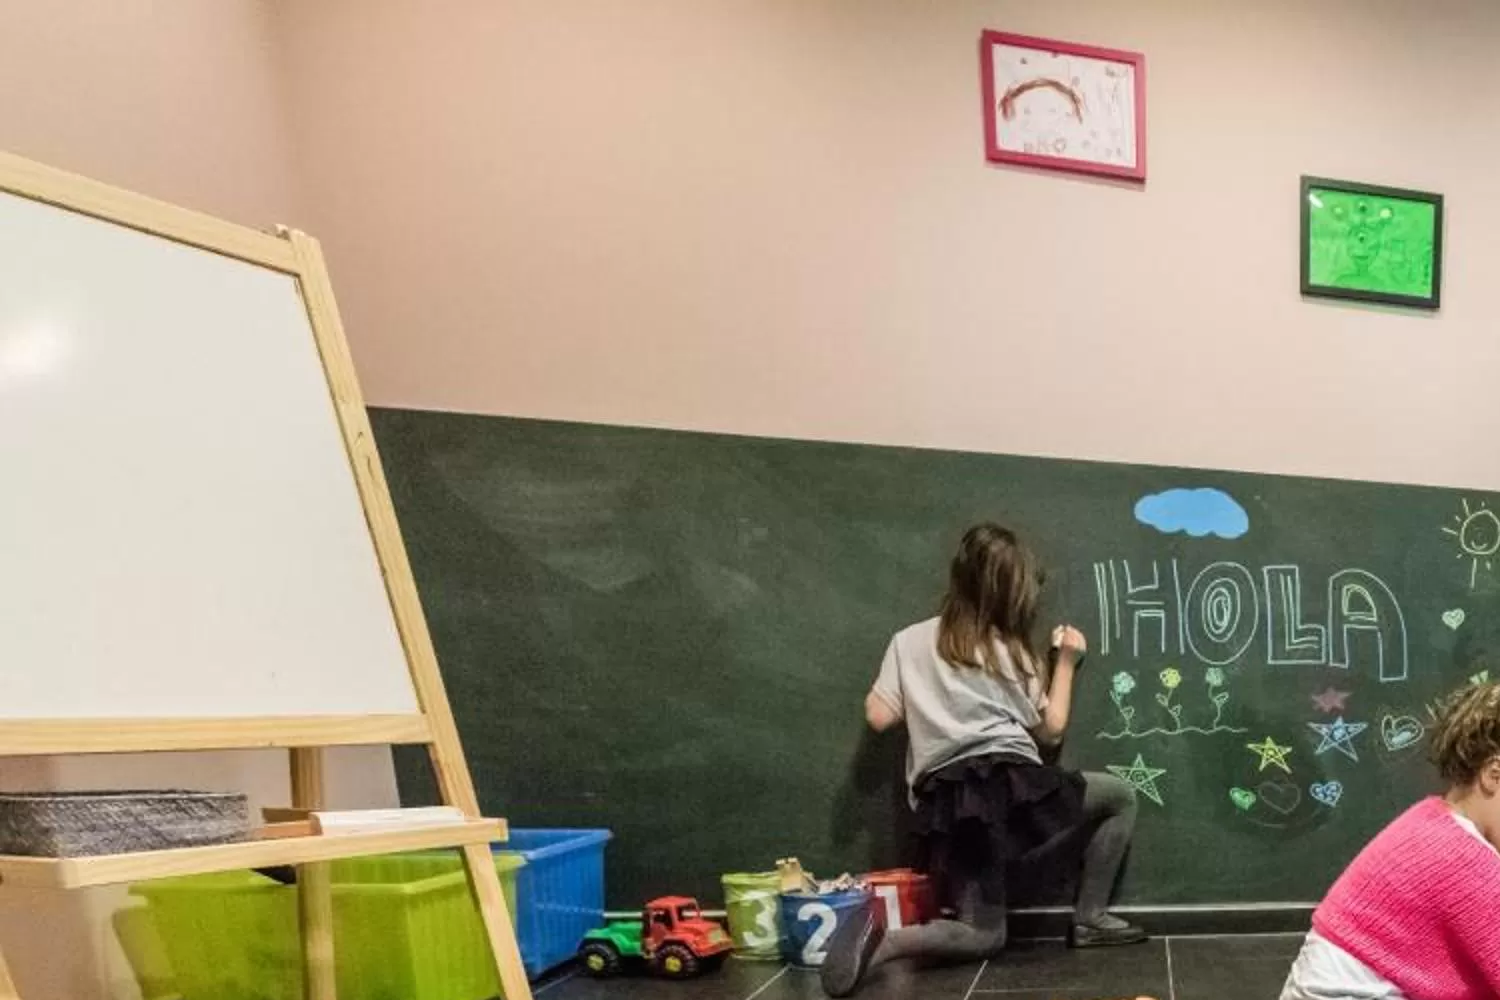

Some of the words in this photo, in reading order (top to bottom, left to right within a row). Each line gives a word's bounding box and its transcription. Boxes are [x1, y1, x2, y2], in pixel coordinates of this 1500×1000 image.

[742, 890, 779, 948] 3
[797, 902, 837, 965] 2
[874, 884, 903, 931] 1
